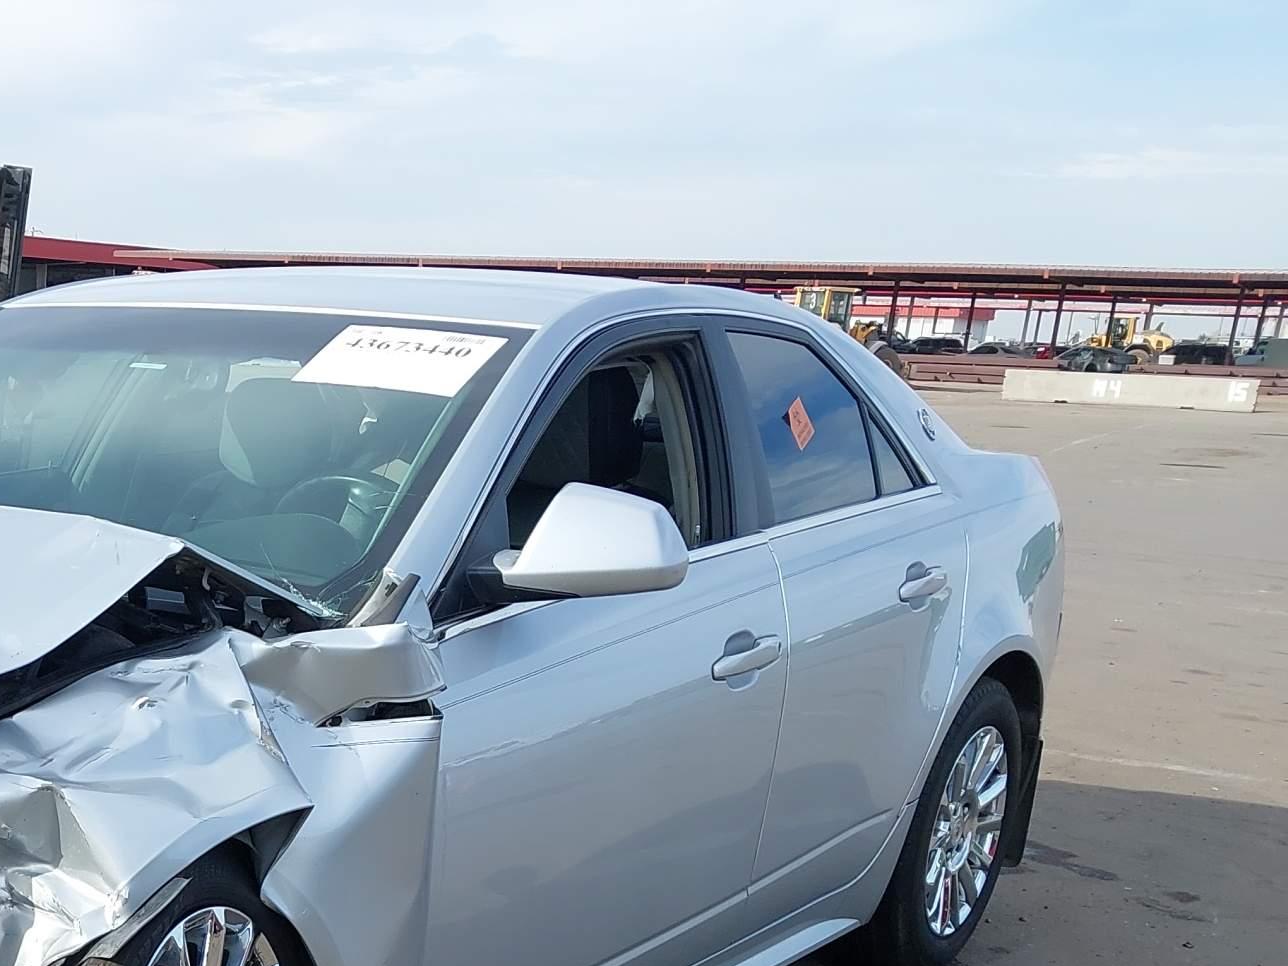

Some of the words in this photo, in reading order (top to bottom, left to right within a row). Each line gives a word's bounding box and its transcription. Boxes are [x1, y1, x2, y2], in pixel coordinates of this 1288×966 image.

[809, 292, 817, 309] 3
[345, 337, 472, 358] 43673440
[1224, 380, 1250, 403] 15
